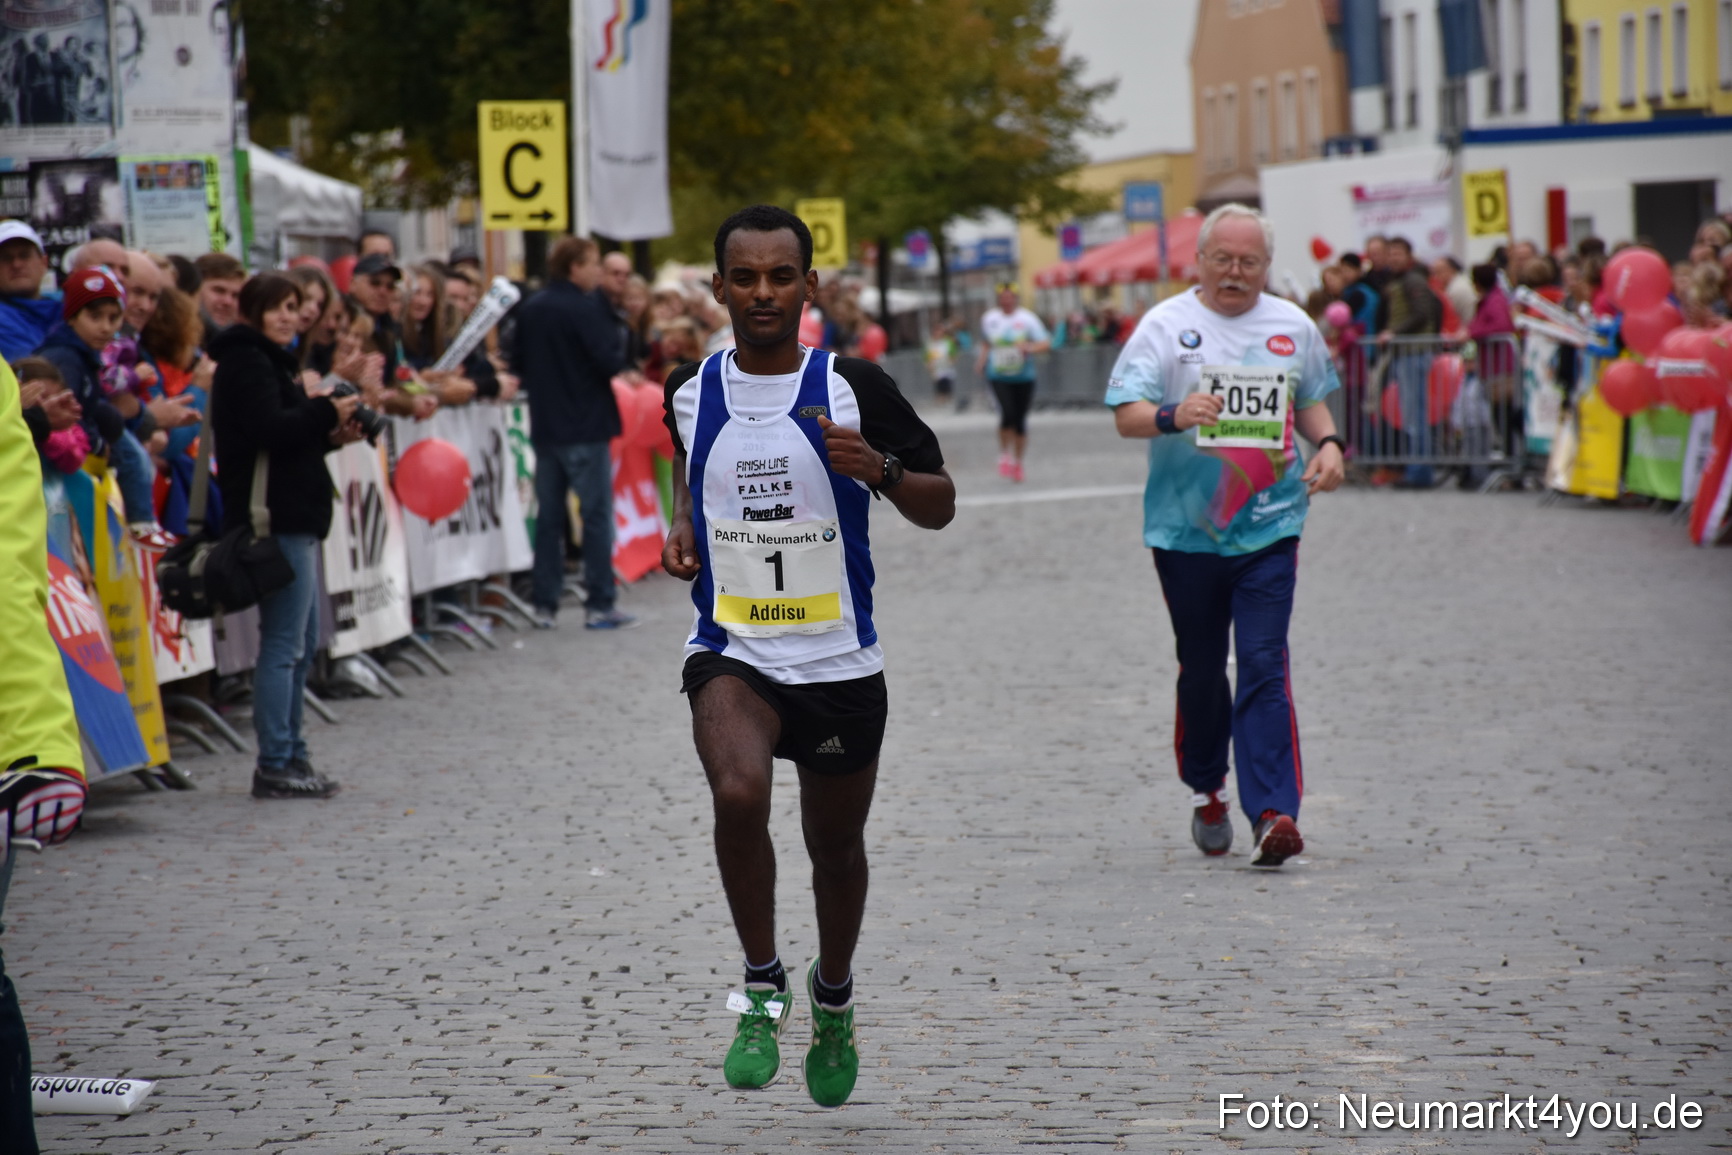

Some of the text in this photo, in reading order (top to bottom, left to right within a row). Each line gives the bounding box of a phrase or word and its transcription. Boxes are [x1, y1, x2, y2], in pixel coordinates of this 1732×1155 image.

[490, 107, 554, 131] Block
[503, 141, 542, 199] C
[1475, 190, 1501, 222] D
[1220, 422, 1266, 436] Gerhard
[736, 456, 789, 472] FINISH LINE
[738, 480, 793, 494] FALKE
[742, 503, 795, 521] PowerBar
[715, 530, 817, 545] PARTL Neumarkt
[765, 551, 784, 591] 1
[749, 604, 806, 621] Addisu
